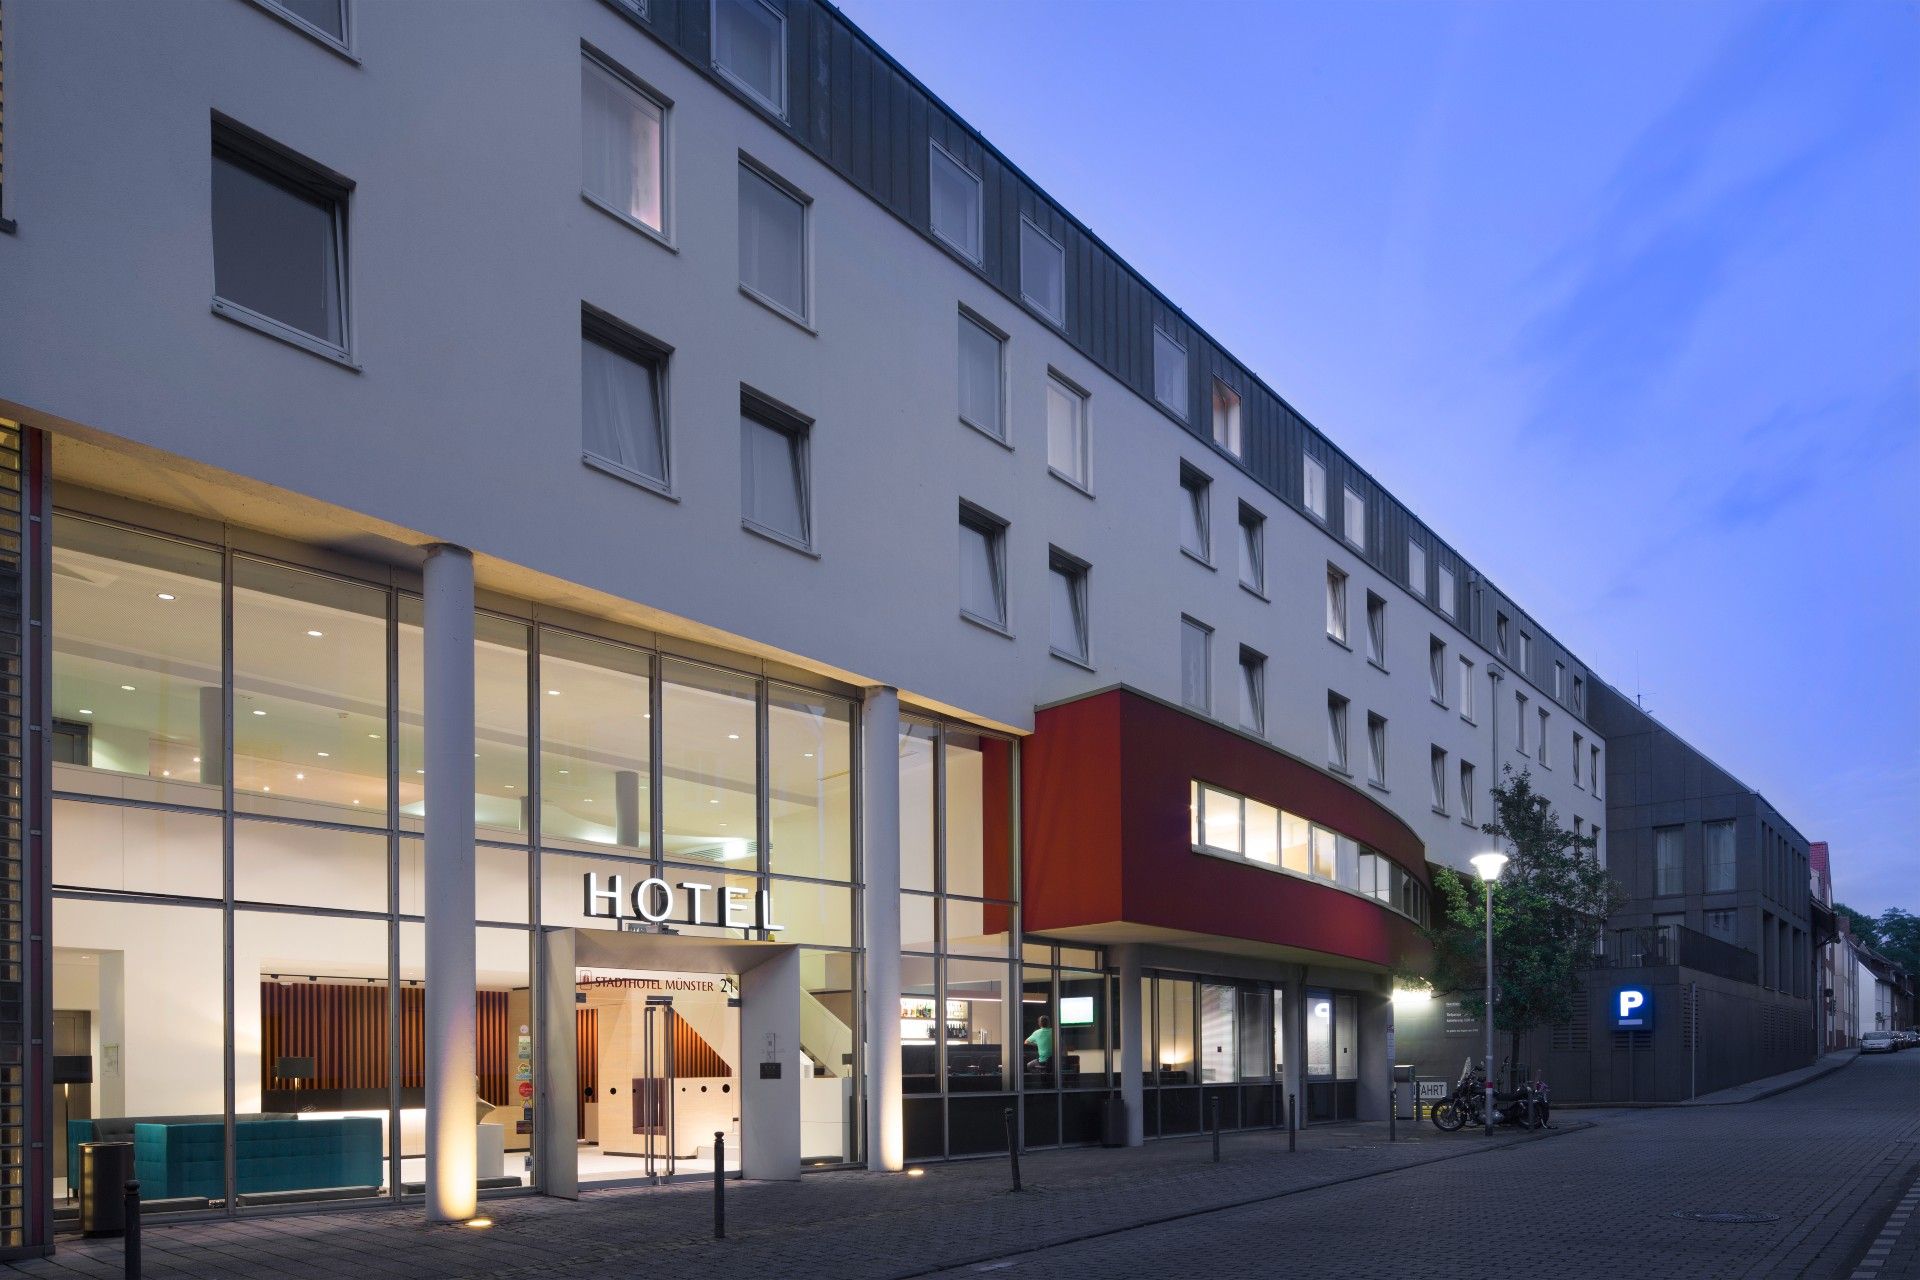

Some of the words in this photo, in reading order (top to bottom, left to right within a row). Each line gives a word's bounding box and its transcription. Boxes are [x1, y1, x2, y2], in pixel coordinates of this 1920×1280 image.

[584, 872, 784, 930] HOTEL
[595, 976, 662, 990] STADTHOTEL
[665, 977, 714, 992] MÜNSTER
[720, 978, 734, 993] 21
[1620, 990, 1643, 1016] P
[1414, 1084, 1444, 1096] AHRT
